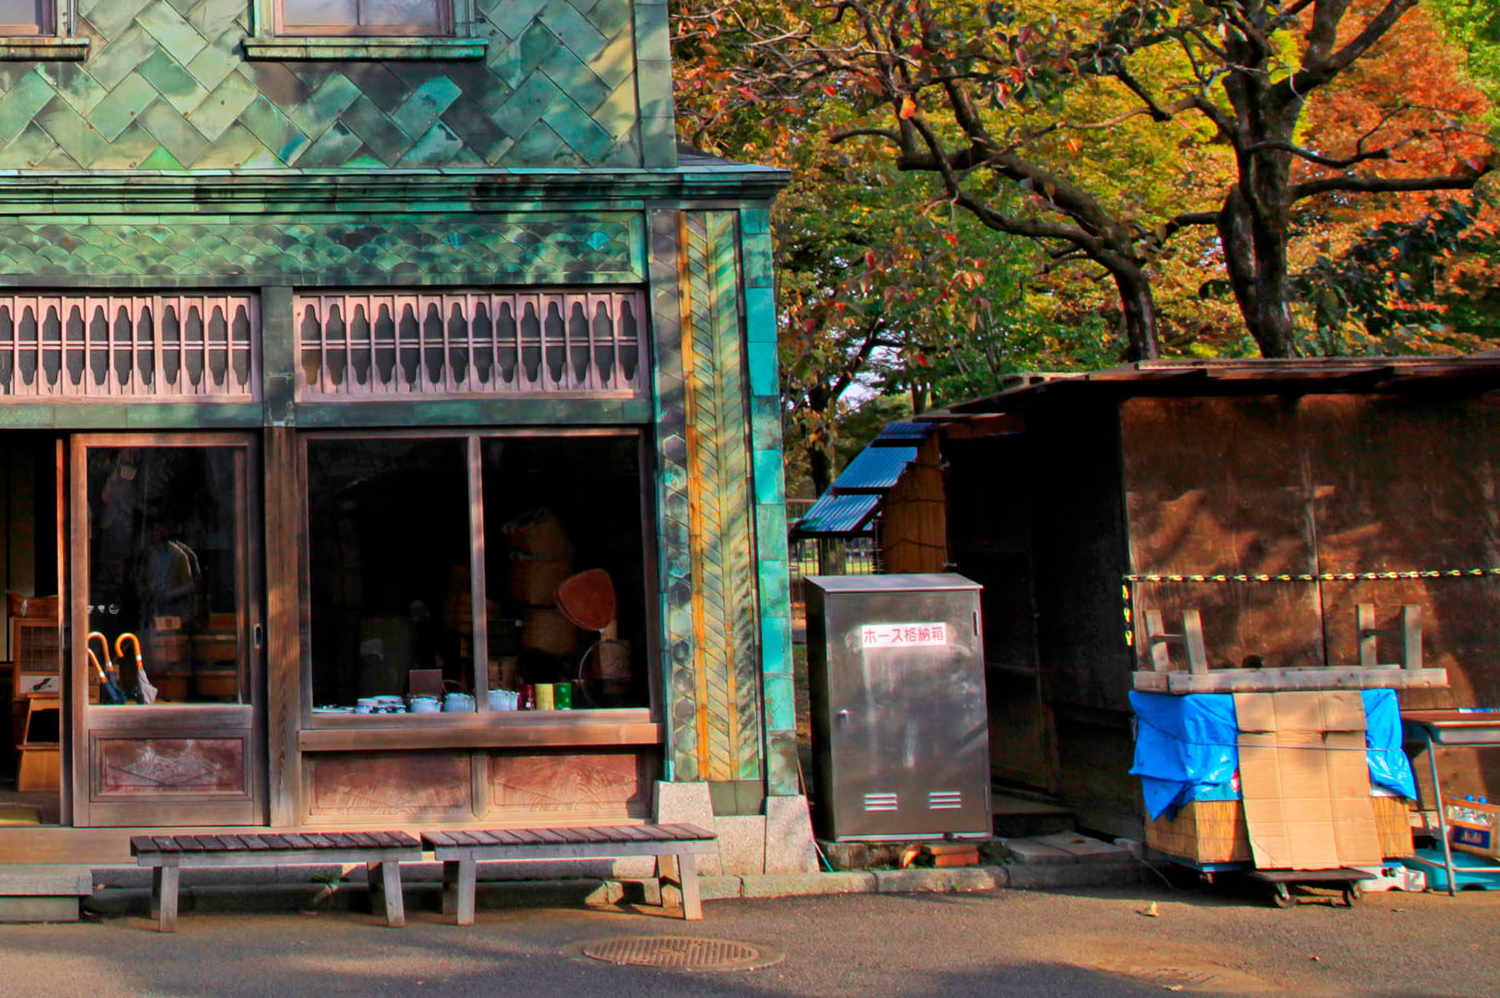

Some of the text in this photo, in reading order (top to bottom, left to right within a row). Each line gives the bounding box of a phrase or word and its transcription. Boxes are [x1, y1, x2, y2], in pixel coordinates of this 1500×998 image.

[863, 626, 944, 644] ホース格納箱
